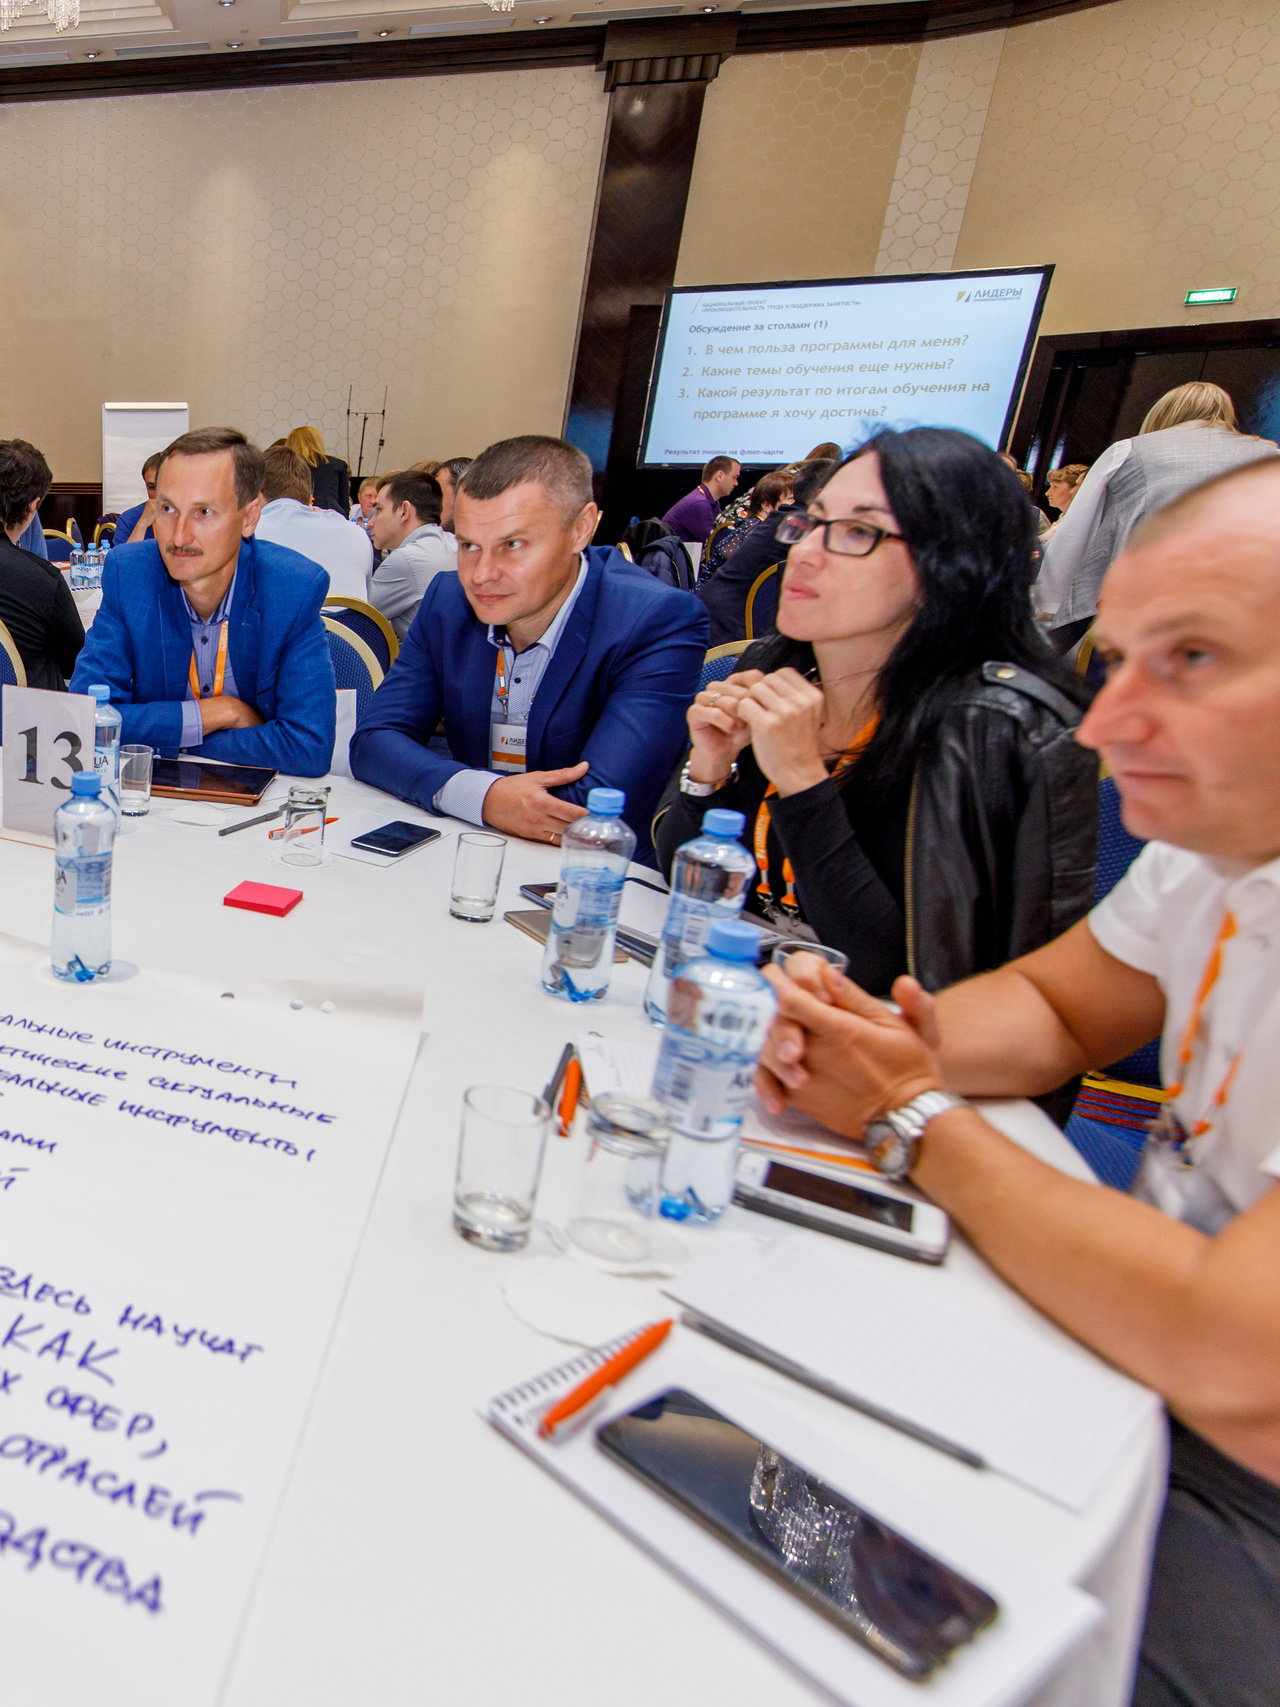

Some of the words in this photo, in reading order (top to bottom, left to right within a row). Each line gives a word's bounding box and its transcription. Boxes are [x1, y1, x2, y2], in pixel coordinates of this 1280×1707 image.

[973, 288, 1023, 298] ЛИДЕРЫ
[702, 300, 745, 308] НАЦИОНАЛЬНЫЙ
[689, 324, 751, 334] Обсуждение
[753, 324, 764, 332] за
[767, 322, 810, 331] столами
[813, 320, 829, 330] (1)
[686, 345, 697, 356] 1.
[705, 344, 714, 355] В
[718, 345, 744, 355] чем
[748, 343, 796, 354] польза
[800, 338, 884, 354] программы
[887, 338, 917, 351] для
[921, 334, 970, 347] меня?
[682, 366, 694, 377] 2.
[701, 366, 742, 376] Какие
[746, 365, 782, 375] темы
[786, 363, 854, 377] обучения
[858, 362, 889, 374] еще
[893, 358, 955, 373] нужны?
[677, 387, 689, 398] 3.
[697, 386, 738, 398] Какой
[740, 386, 811, 400] результат
[814, 387, 832, 396] по
[836, 384, 888, 395] итогам
[892, 381, 967, 396] обучения
[971, 382, 991, 392] на
[693, 408, 767, 421] программе
[771, 408, 780, 418] я
[783, 408, 816, 420] хочу
[819, 405, 888, 419] достичь?
[664, 448, 700, 456] Результат
[739, 448, 785, 456] флип-чарте
[18, 726, 84, 790] 13
